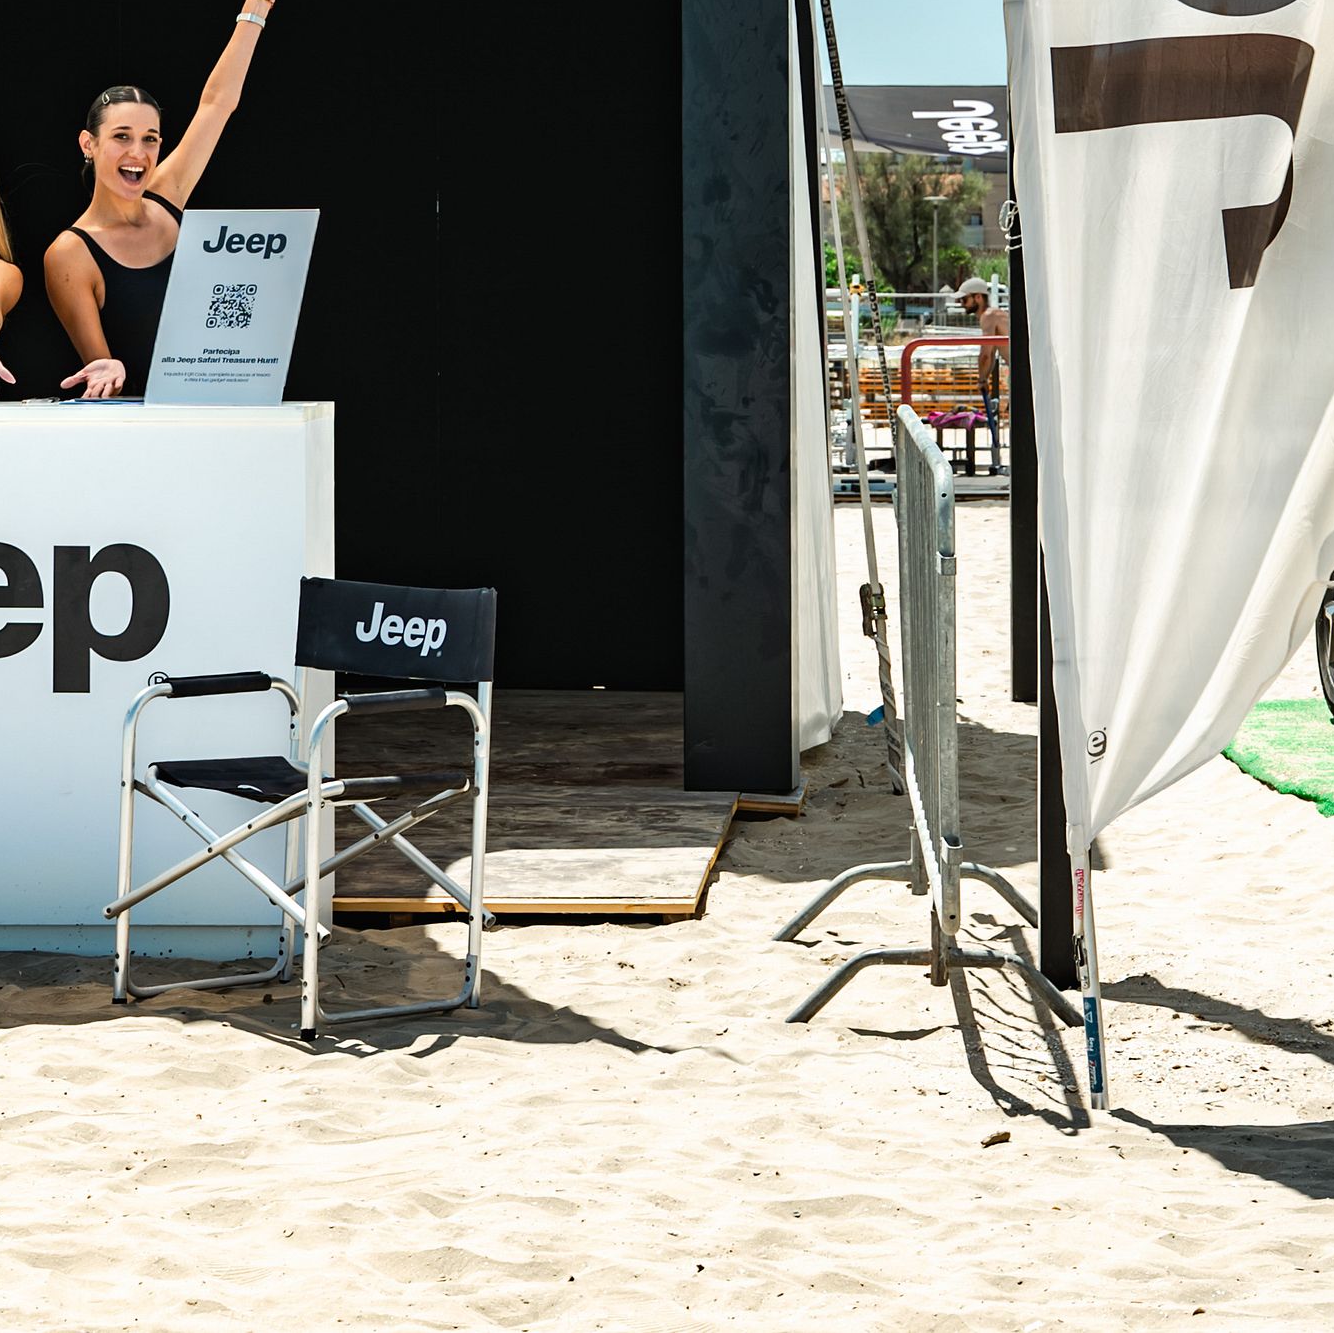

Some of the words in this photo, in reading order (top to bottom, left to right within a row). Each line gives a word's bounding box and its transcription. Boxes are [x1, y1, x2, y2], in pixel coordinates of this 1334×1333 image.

[203, 226, 287, 259] Jeep
[202, 348, 241, 356] Partecipa
[355, 602, 447, 657] Jeep
